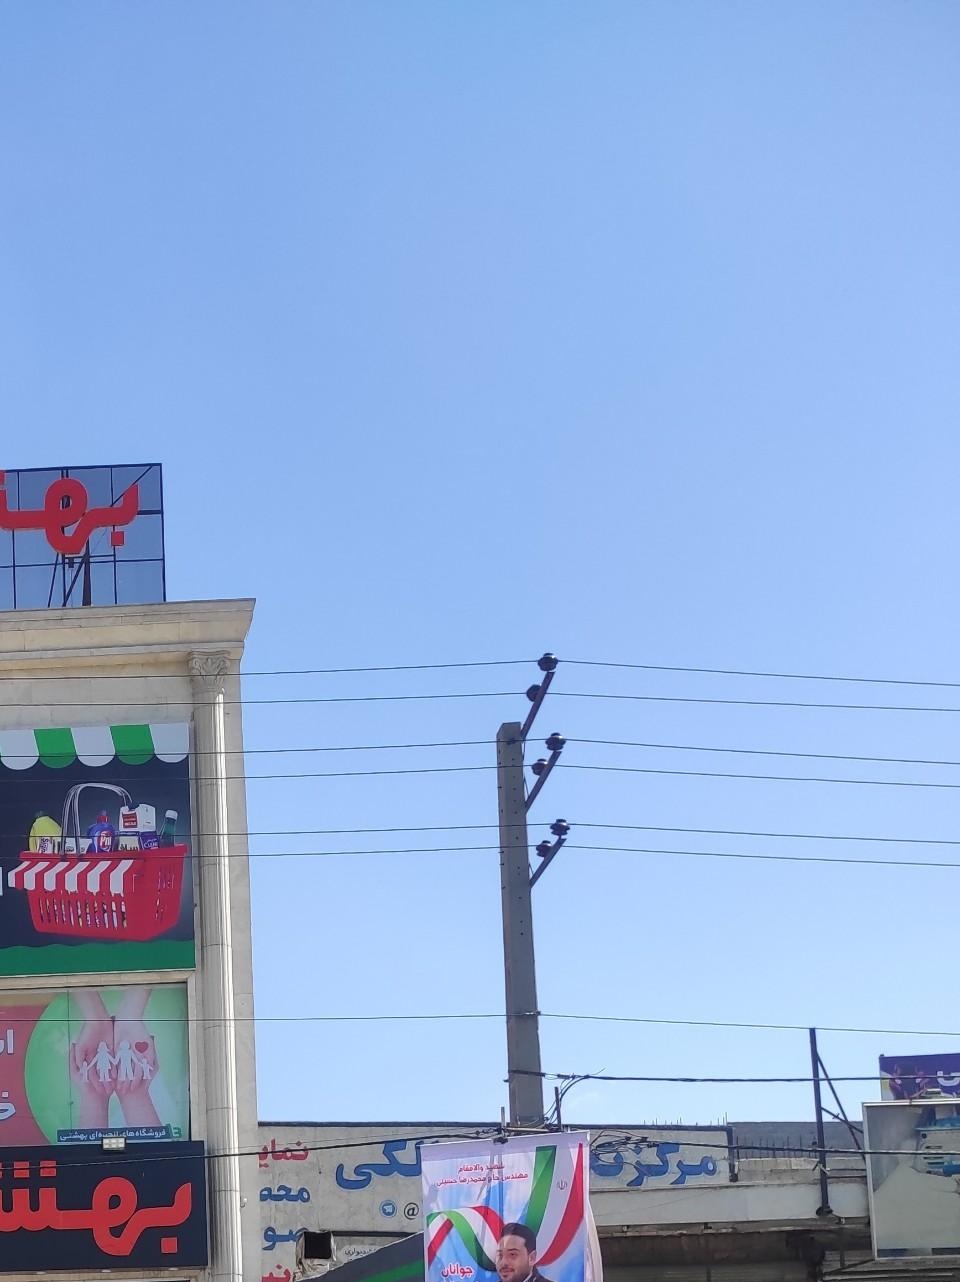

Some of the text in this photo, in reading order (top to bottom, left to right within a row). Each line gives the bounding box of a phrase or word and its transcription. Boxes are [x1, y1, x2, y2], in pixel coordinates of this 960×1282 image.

[336, 1139, 424, 1190] لکی
[627, 1143, 718, 1187] مرکز
[441, 1263, 473, 1278] جوانان
